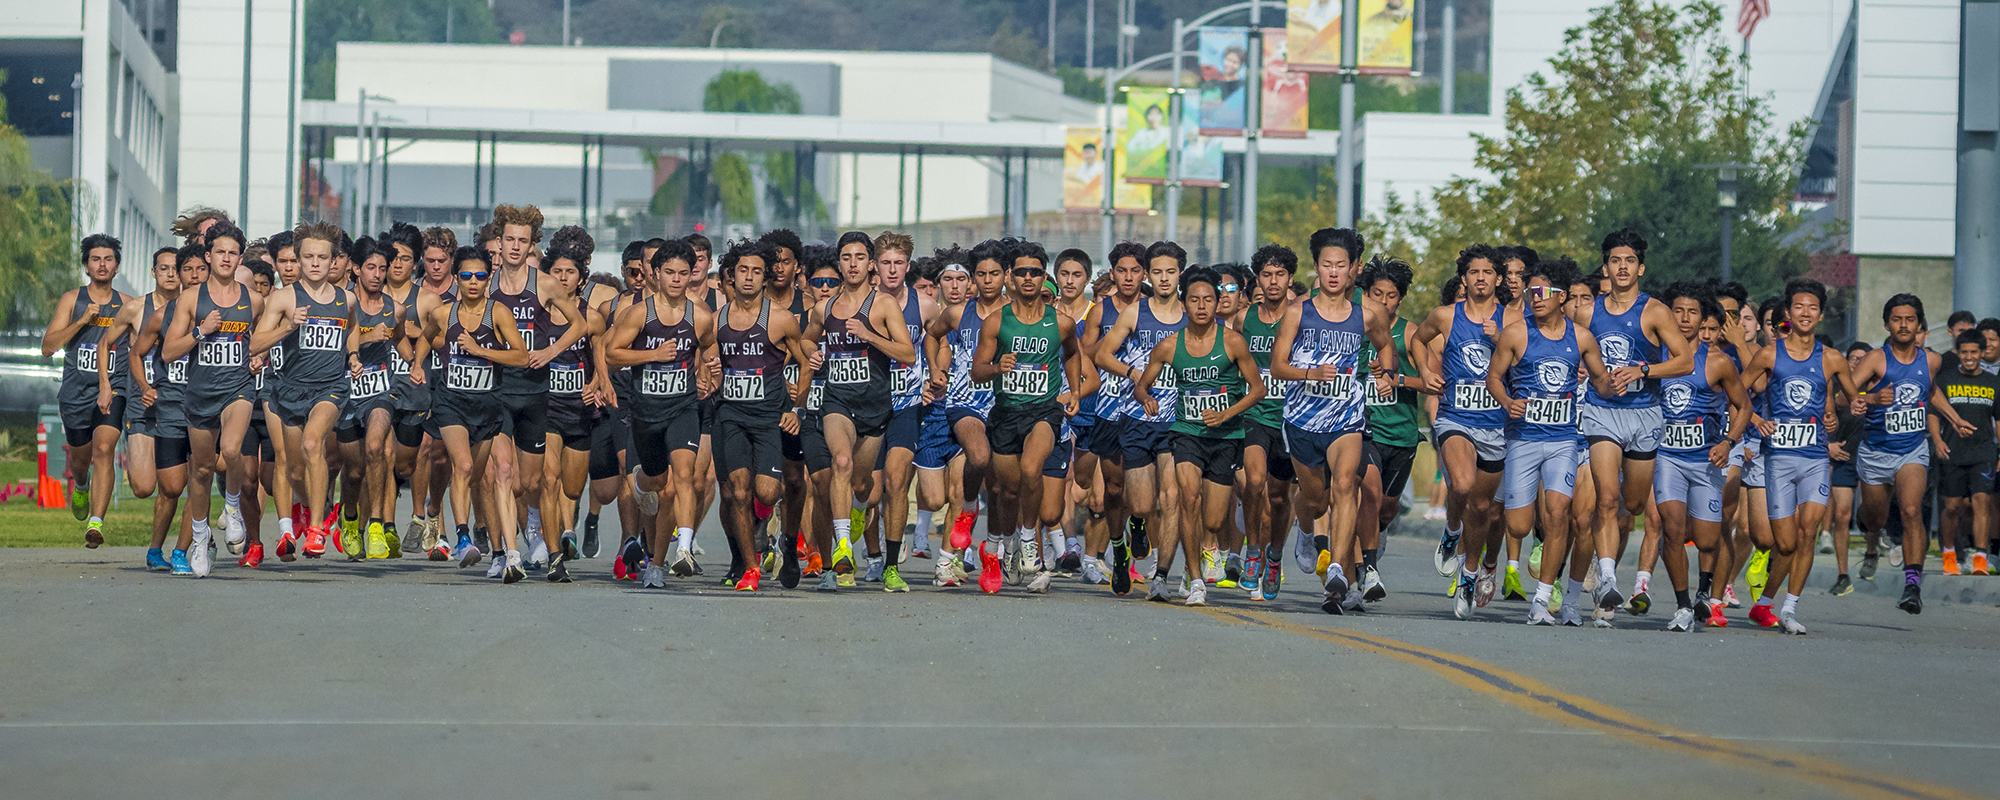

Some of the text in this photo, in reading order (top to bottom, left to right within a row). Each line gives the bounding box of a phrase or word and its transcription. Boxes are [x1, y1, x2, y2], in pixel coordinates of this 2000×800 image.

[513, 307, 534, 320] SAC
[305, 326, 341, 349] 3627
[721, 342, 764, 356] MT. SAC
[961, 329, 974, 350] EL
[1012, 336, 1049, 354] ELAC
[1139, 330, 1153, 351] EL
[1303, 329, 1361, 355] EL CAMINO
[82, 350, 115, 372] 360
[204, 343, 241, 365] 3619
[454, 365, 492, 388] 3577
[649, 370, 686, 393] 3573
[833, 359, 868, 382] 3585
[1009, 371, 1047, 393] 3482
[1182, 365, 1219, 382] ELAC
[352, 371, 388, 396] 3621
[727, 376, 763, 399] 3572
[1312, 375, 1351, 398] 3504
[1947, 384, 1995, 400] HARBOR
[1190, 394, 1228, 418] 3486
[1532, 399, 1569, 422] 3461
[1891, 408, 1925, 433] 3459
[1665, 425, 1703, 447] 3453
[1778, 424, 1816, 447] 3472
